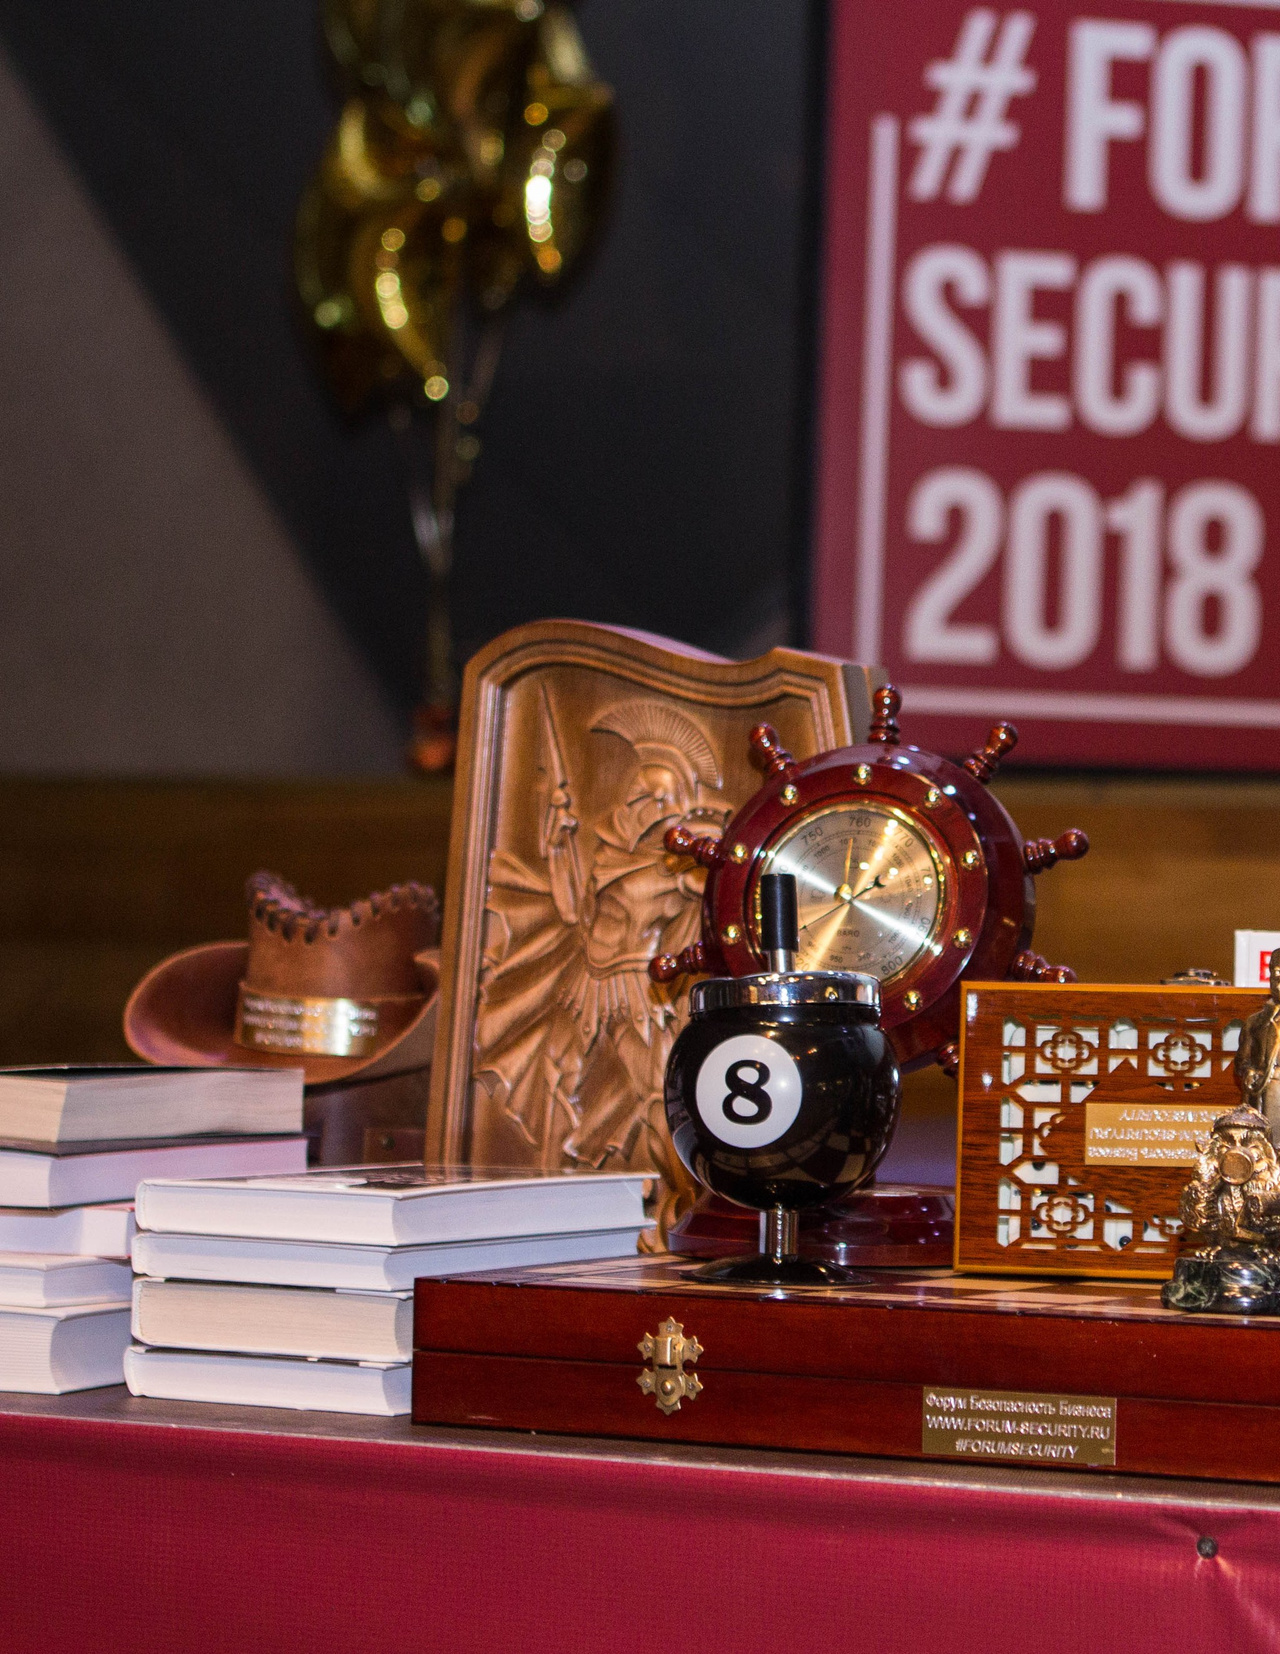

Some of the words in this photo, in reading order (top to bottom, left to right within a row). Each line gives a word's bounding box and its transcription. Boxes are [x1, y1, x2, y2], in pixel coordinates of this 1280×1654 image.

[904, 467, 1265, 677] 2018
[850, 816, 872, 828] 760
[801, 827, 823, 845] 750
[881, 955, 904, 976] 800
[722, 1059, 773, 1126] 8
[926, 1391, 967, 1412] Форум
[970, 1394, 1056, 1414] Безопасность
[1059, 1400, 1112, 1419] Бизнеса
[926, 1414, 1111, 1440] WWW.FORUM-SECURITY.RU
[955, 1438, 1079, 1459] #FORUMSECURITY
